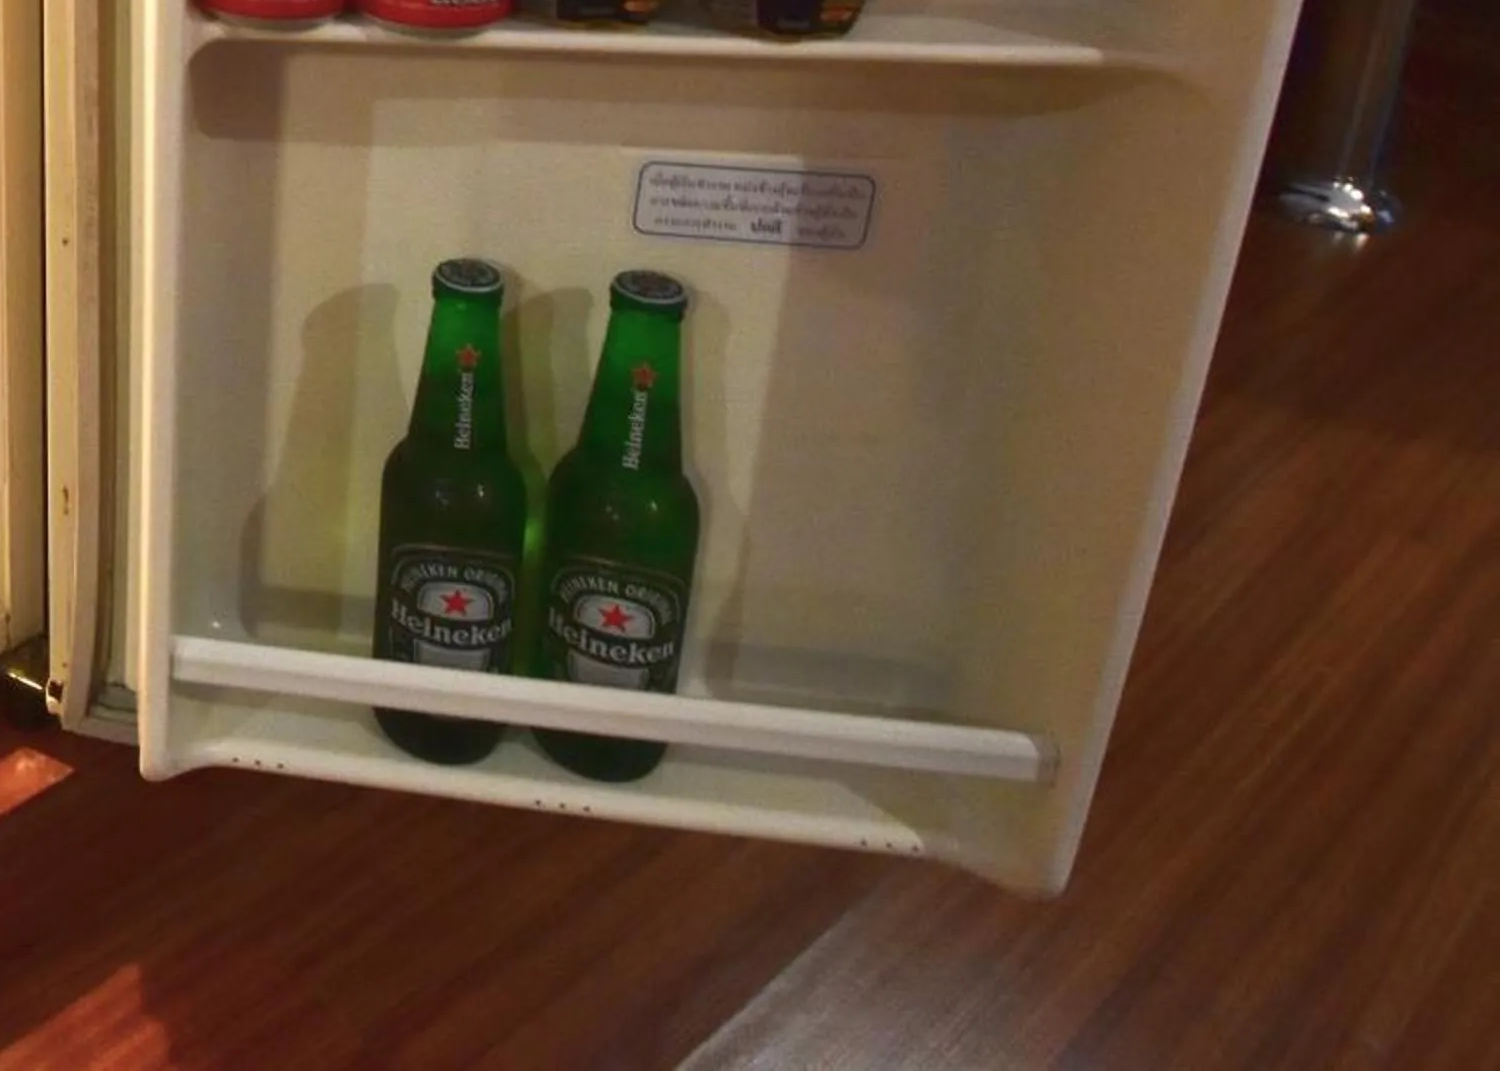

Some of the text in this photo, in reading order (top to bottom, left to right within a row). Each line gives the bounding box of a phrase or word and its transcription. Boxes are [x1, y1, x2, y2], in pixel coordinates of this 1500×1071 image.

[621, 389, 649, 470] Heineken
[391, 596, 512, 646] Heineken
[548, 605, 675, 665] Heineken
